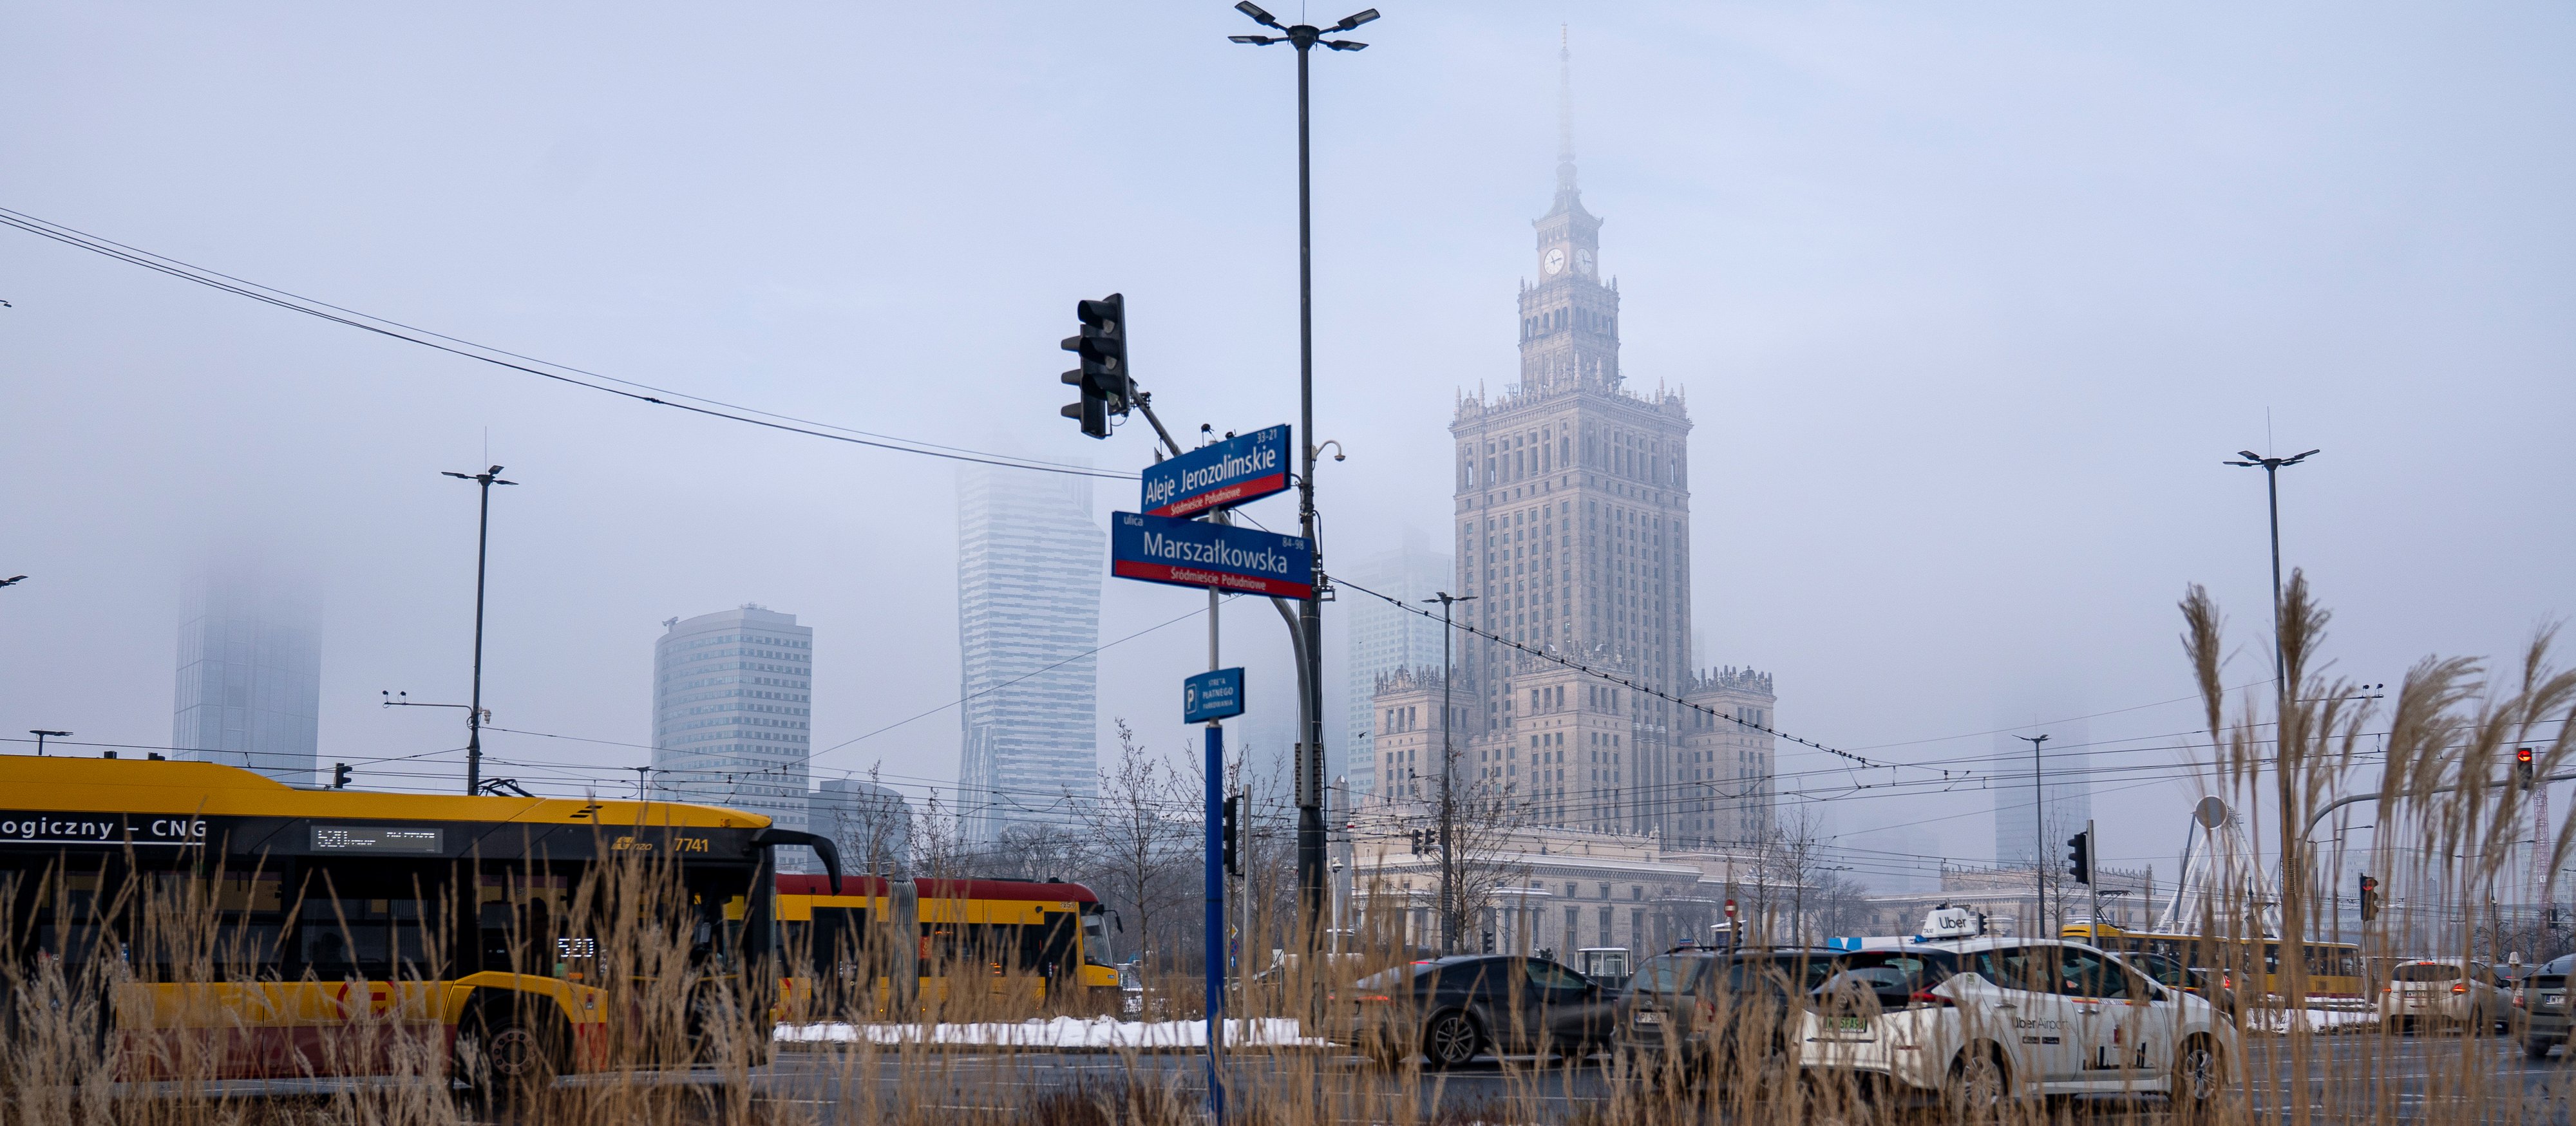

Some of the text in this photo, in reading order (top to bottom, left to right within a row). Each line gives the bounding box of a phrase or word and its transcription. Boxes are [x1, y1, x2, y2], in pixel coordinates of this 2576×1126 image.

[1257, 429, 1278, 444] 33-21
[1145, 445, 1276, 505] Aleje Jerozolimskie
[1123, 515, 1144, 527] ulica
[1282, 537, 1305, 550] 84-98
[1144, 532, 1287, 574] Marszałkowska
[1171, 566, 1267, 590] Śródmieście Południowe
[1, 817, 114, 840] ogiczny
[152, 820, 207, 837] CNG
[675, 838, 708, 852] 7741
[1939, 917, 1967, 929] Uber
[558, 938, 594, 957] 520
[2011, 1016, 2069, 1031] Uber Airport
